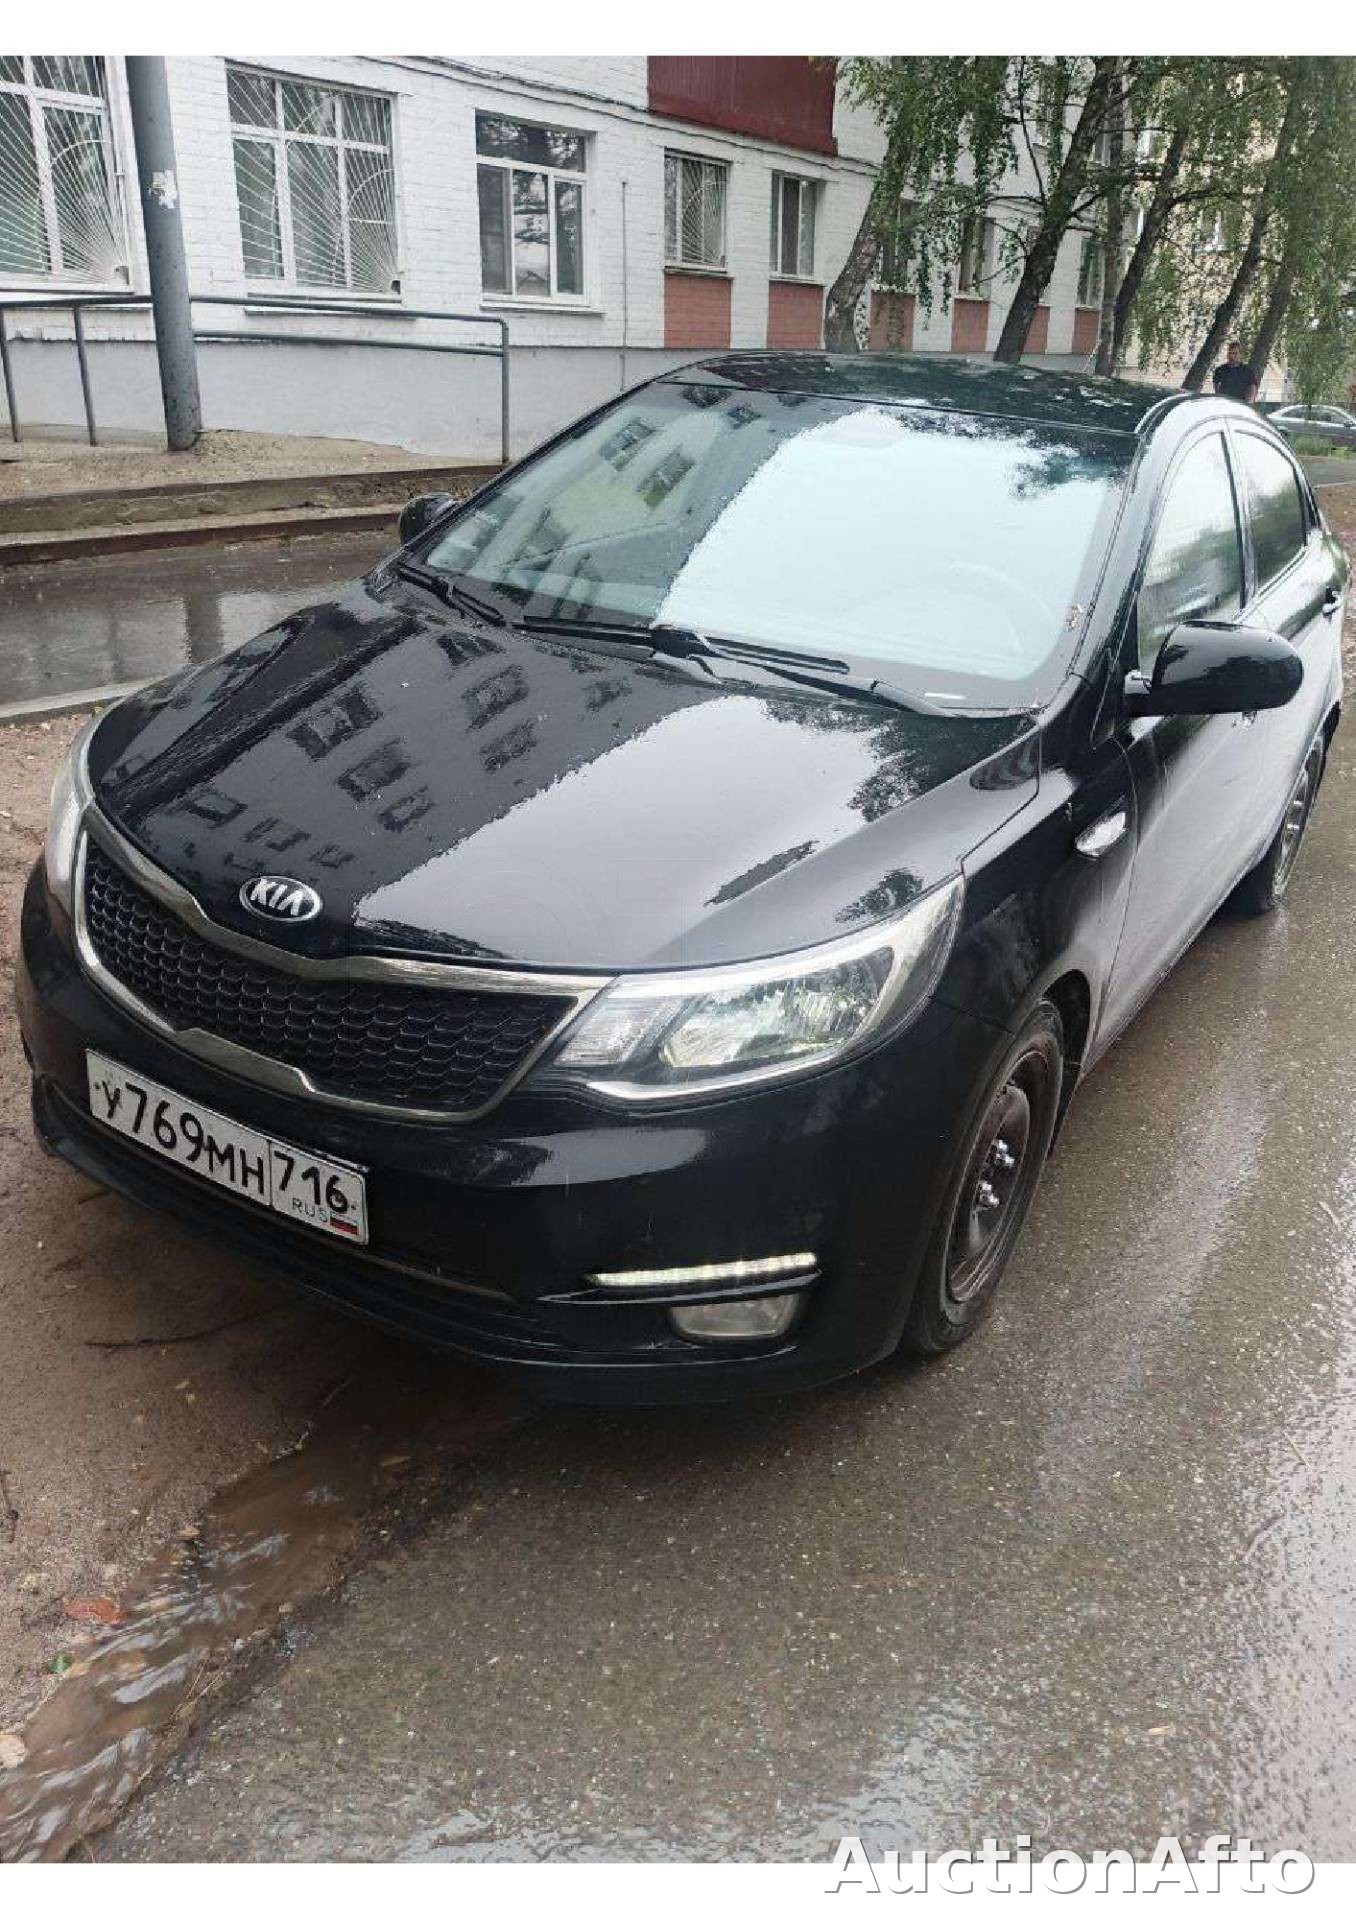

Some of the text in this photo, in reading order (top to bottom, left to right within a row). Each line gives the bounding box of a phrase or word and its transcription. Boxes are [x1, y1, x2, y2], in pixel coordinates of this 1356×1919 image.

[250, 878, 304, 916] KIA
[273, 1150, 349, 1213] 716
[292, 1197, 328, 1223] RUS
